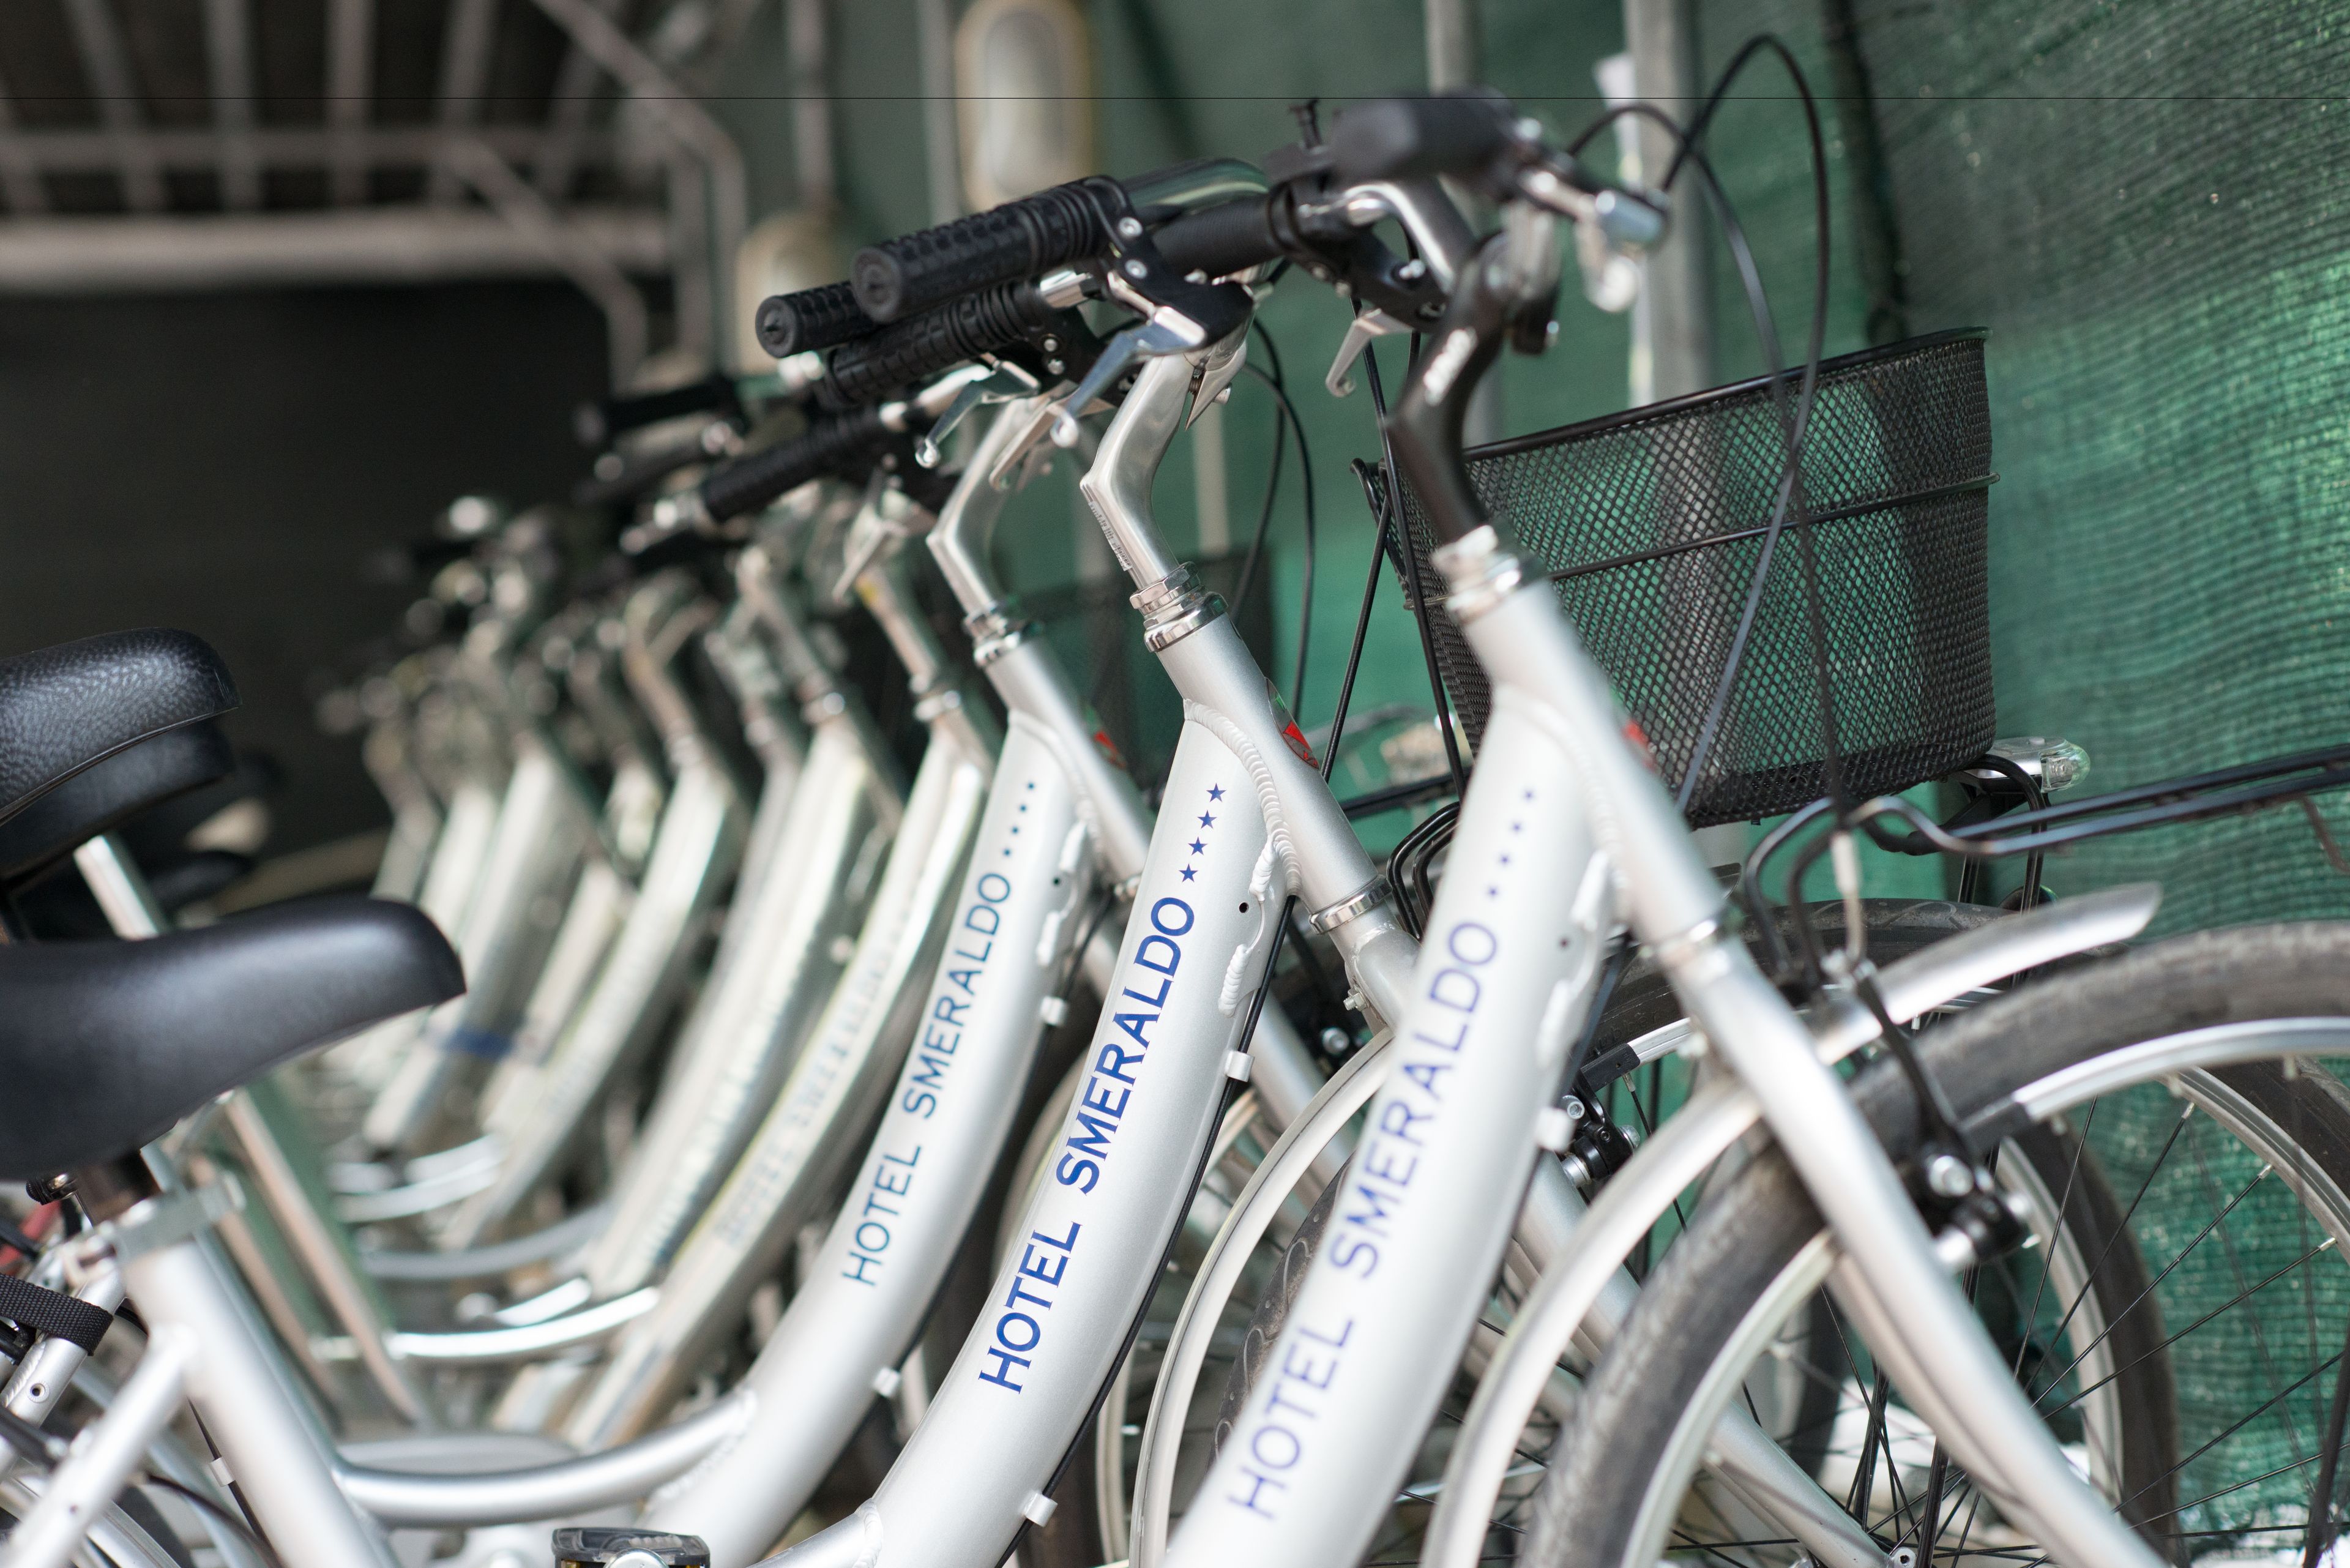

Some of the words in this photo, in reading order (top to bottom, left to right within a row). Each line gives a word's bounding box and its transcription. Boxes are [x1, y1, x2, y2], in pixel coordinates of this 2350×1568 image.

[842, 1144, 921, 1286] HOTEL
[903, 873, 1012, 1119] SMERALDO
[979, 1222, 1081, 1394] HOTEL
[1056, 897, 1195, 1195] SMERALDO
[1226, 1317, 1354, 1520] HOTEL
[1328, 921, 1499, 1280] SMERALDO
